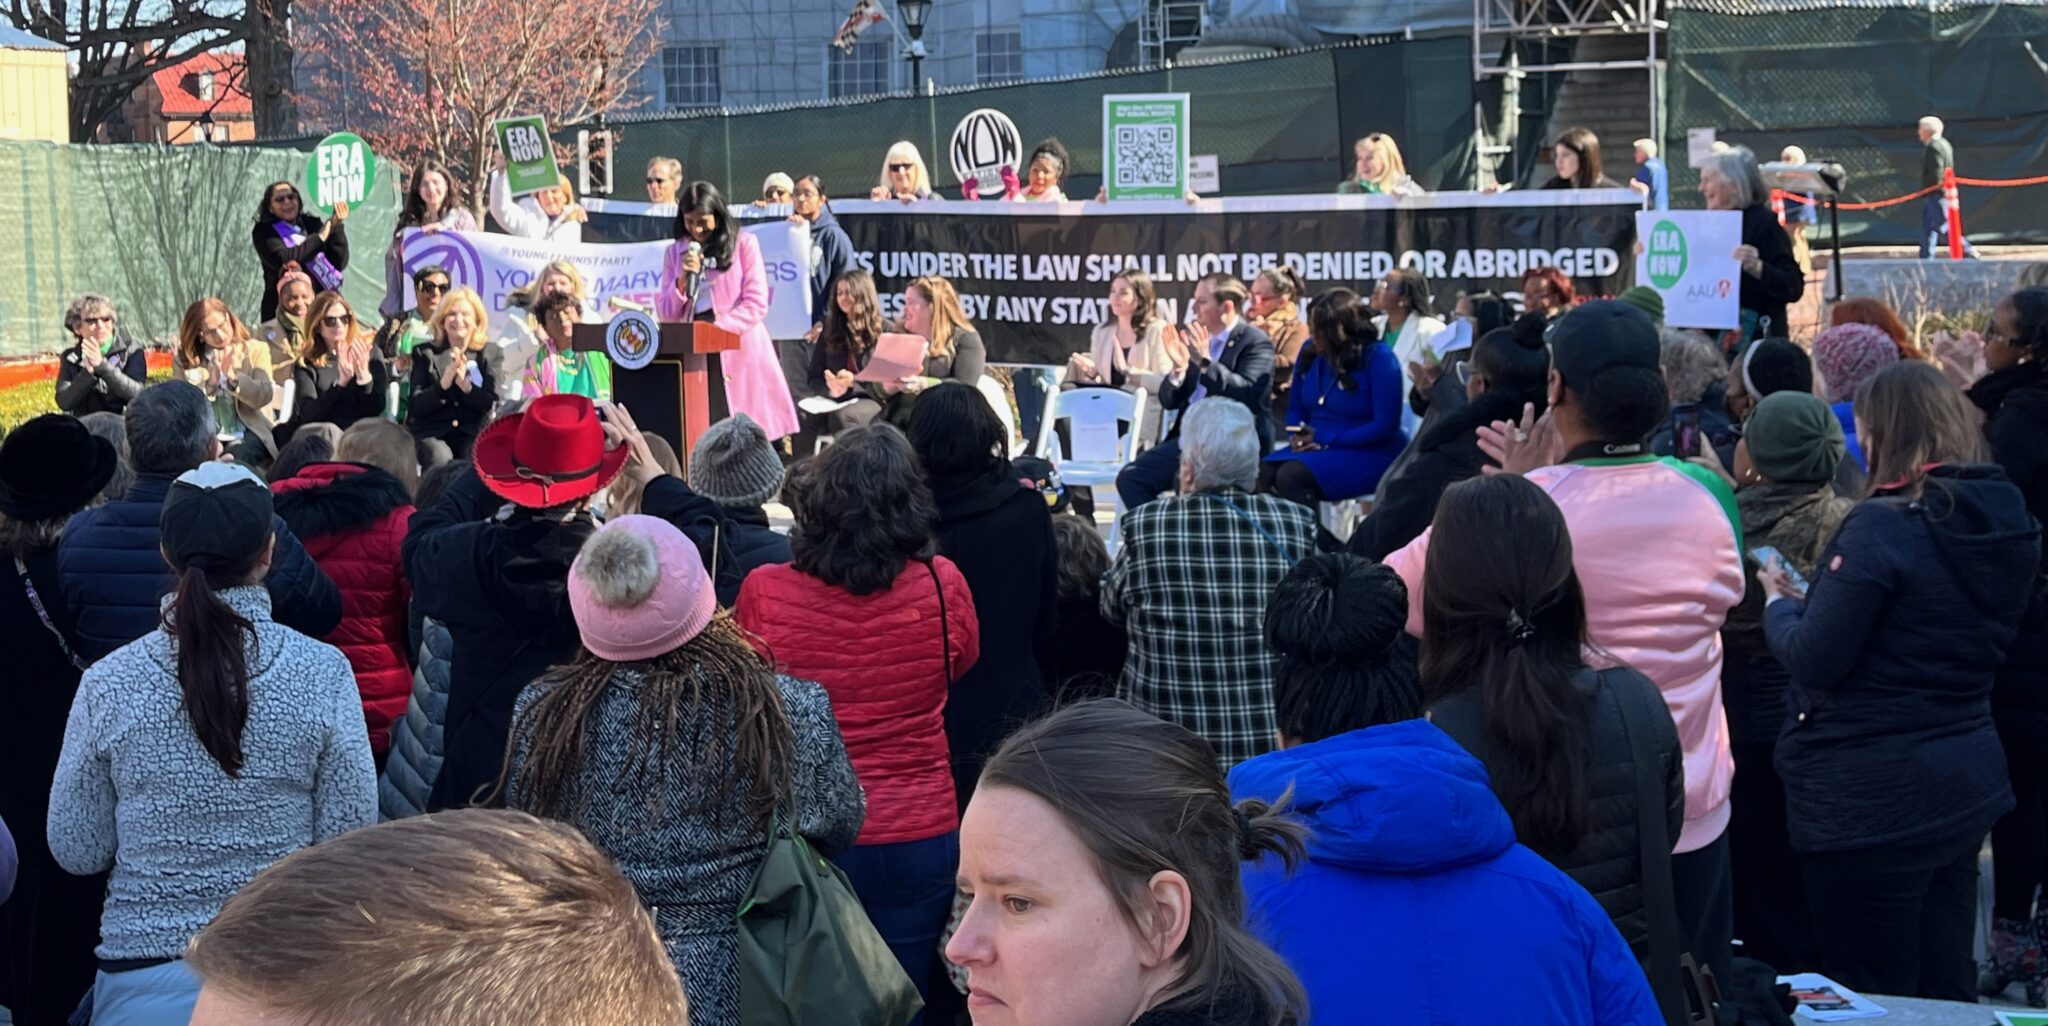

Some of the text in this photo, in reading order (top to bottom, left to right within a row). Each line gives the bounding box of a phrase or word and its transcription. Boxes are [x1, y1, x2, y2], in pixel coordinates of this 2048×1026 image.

[506, 125, 541, 146] ERA
[954, 114, 1016, 172] NOW
[317, 142, 365, 178] ERA
[510, 141, 544, 163] NOW
[317, 173, 365, 208] NOW
[1653, 229, 1681, 252] ERA
[511, 248, 549, 259] YOUNG
[600, 256, 634, 266] PARTY
[879, 251, 968, 279] UNDER
[969, 254, 1018, 279] THE
[1022, 254, 1081, 281] LAW
[1085, 254, 1172, 282] SHALL
[1177, 253, 1238, 281] NOT
[1284, 251, 1394, 280] DENIED
[1400, 249, 1447, 278] OR
[1451, 248, 1619, 278] ABRIDGED
[1650, 254, 1682, 277] NOW
[964, 294, 991, 320] BY
[996, 296, 1047, 323] ANY
[1051, 297, 1109, 324] STAT
